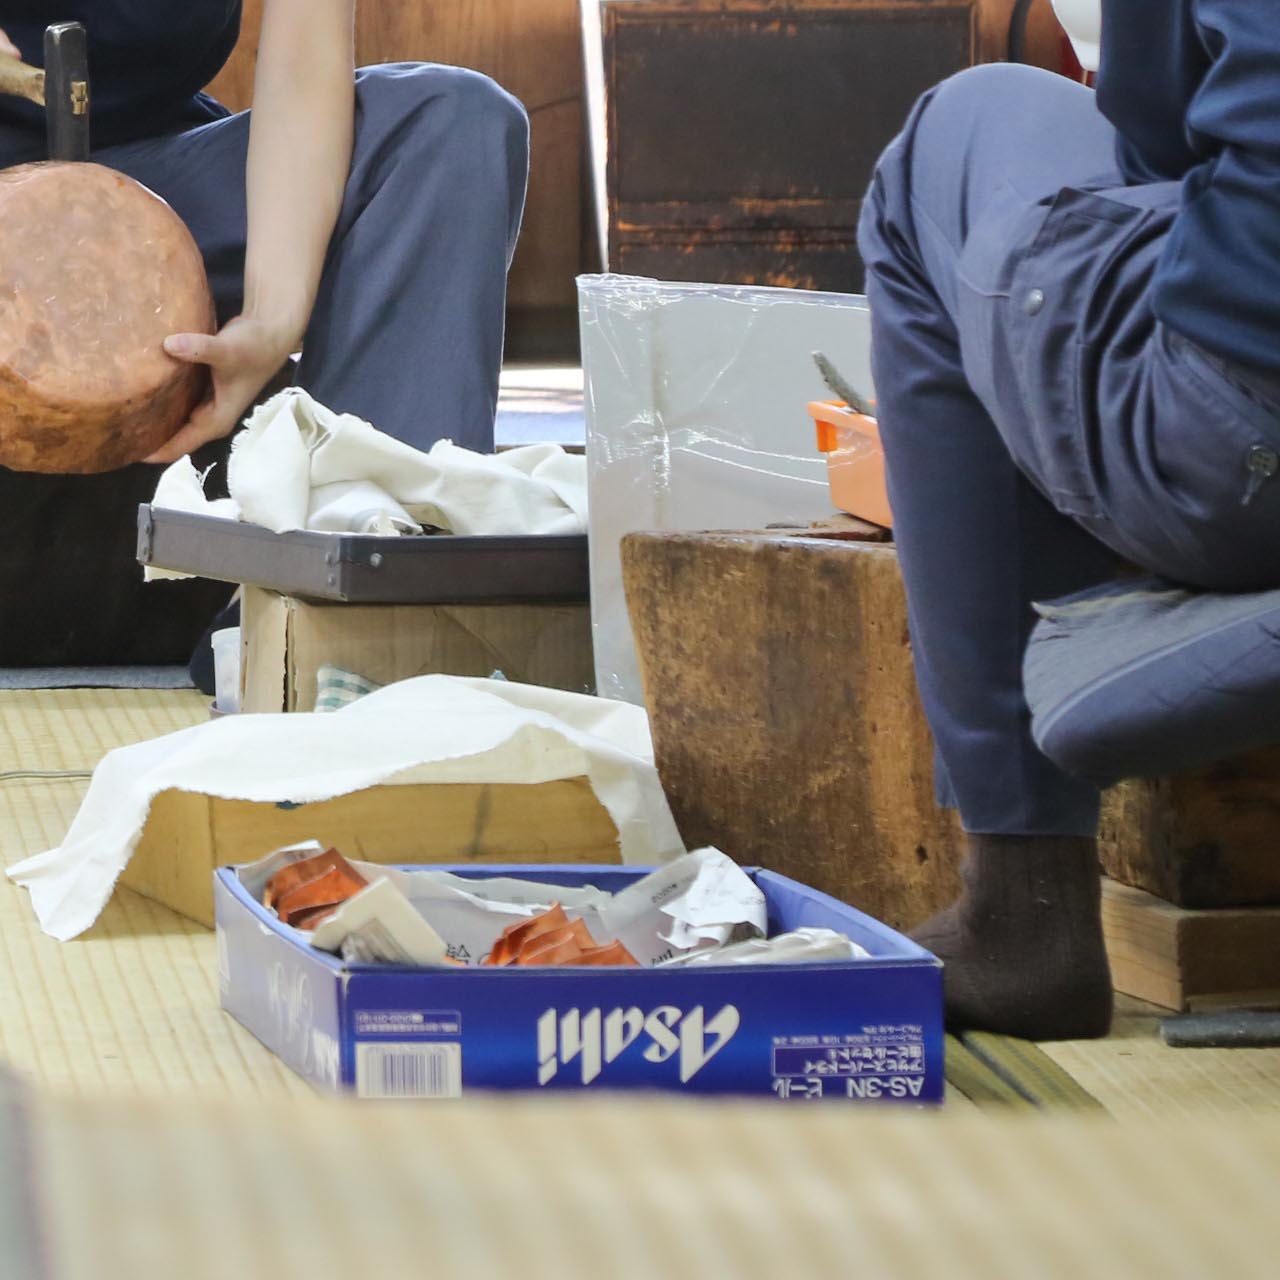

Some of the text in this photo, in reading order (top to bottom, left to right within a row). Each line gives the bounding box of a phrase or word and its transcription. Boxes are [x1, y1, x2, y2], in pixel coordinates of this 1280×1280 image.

[537, 1004, 740, 1086] Asahi
[772, 1077, 925, 1099] AS-3N ビール
